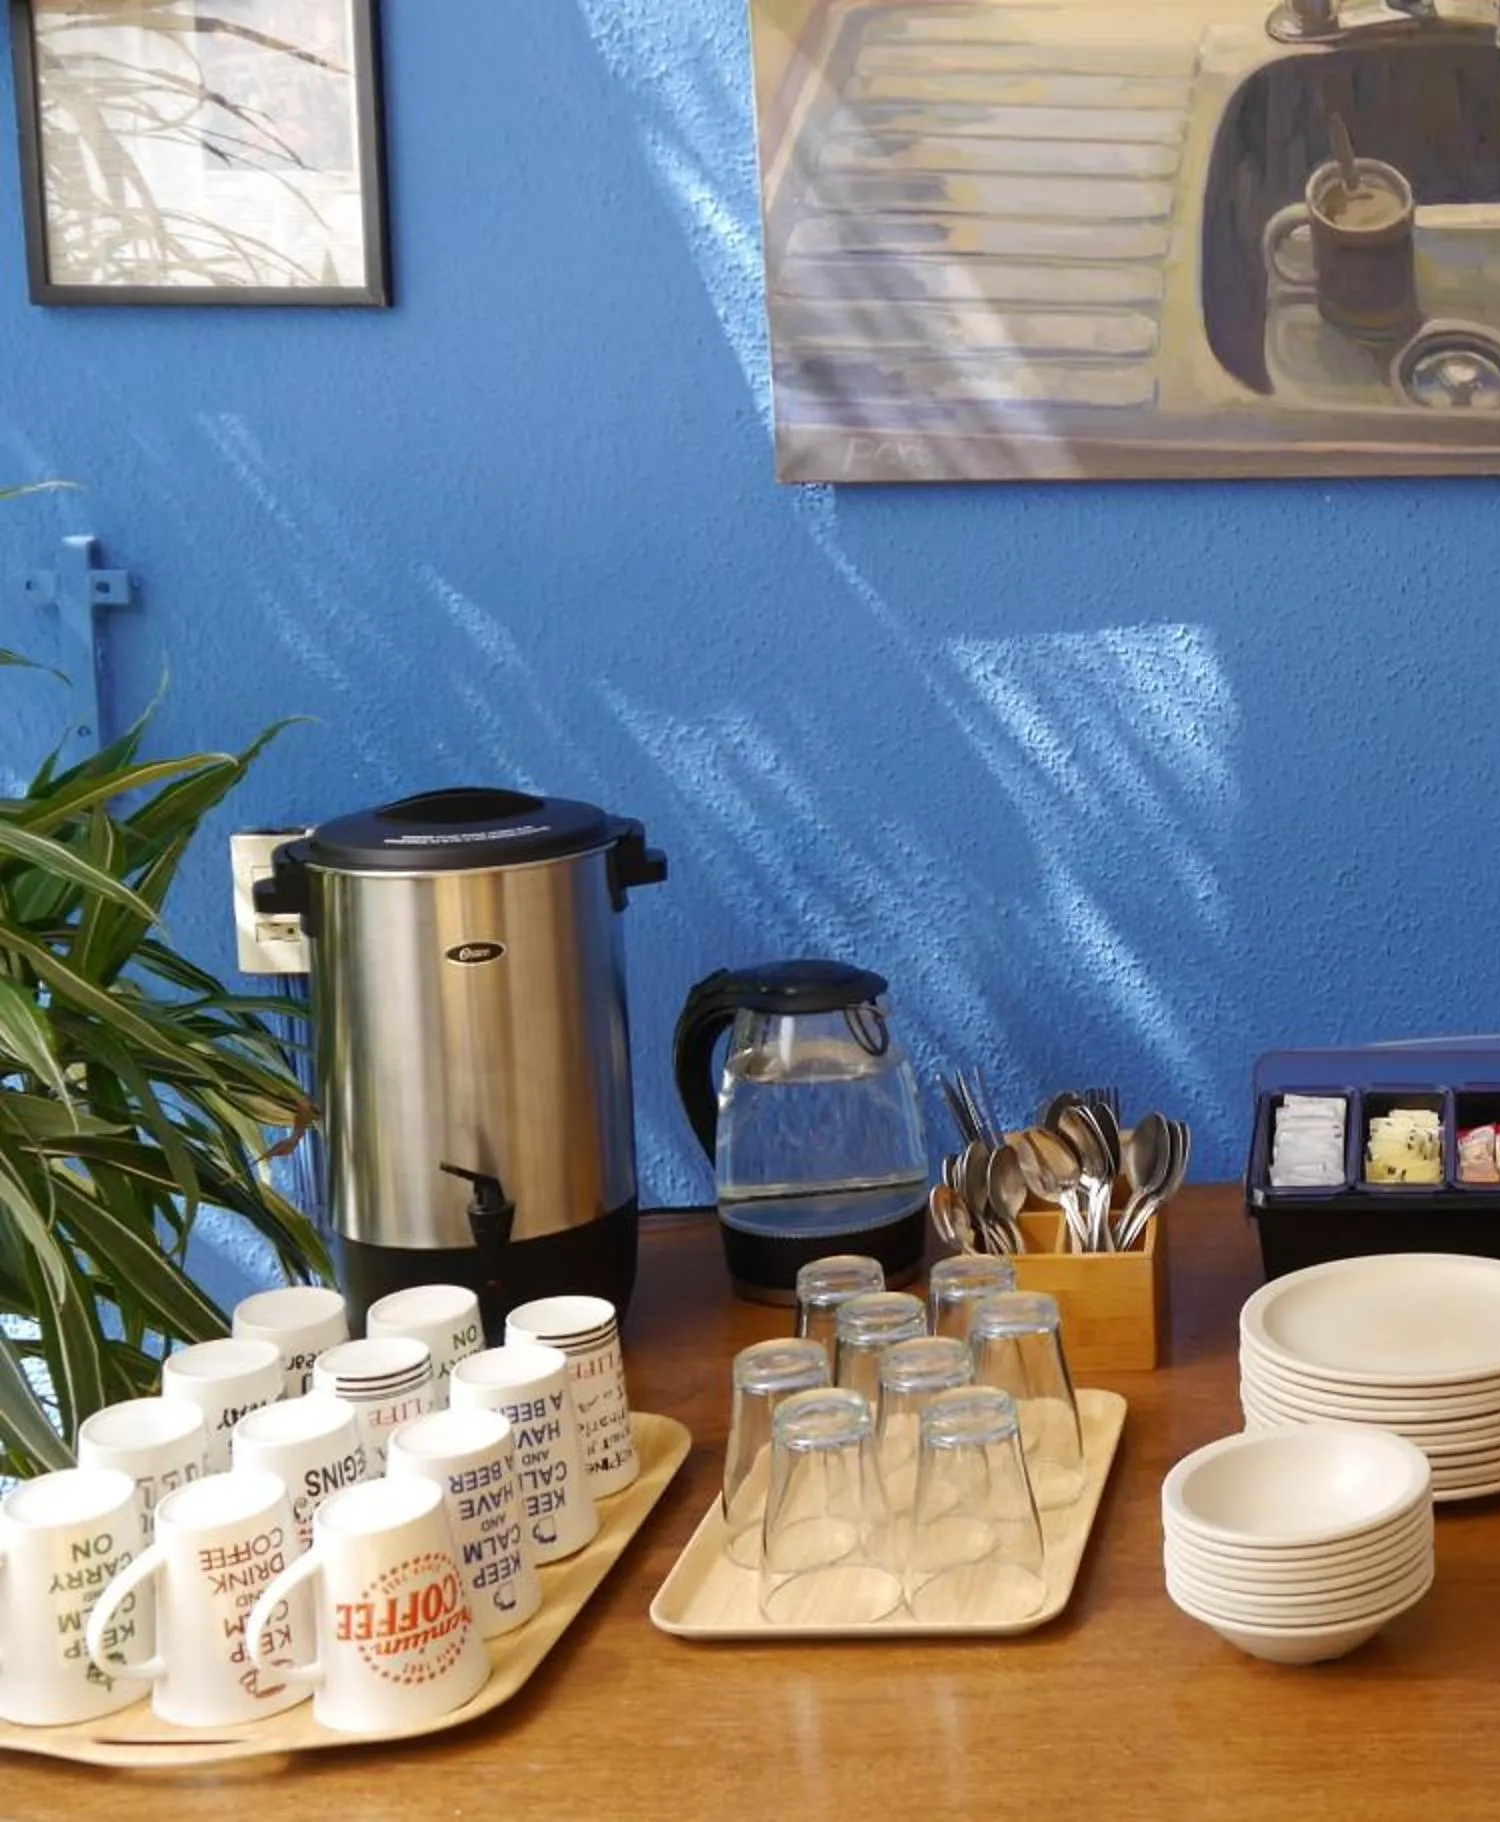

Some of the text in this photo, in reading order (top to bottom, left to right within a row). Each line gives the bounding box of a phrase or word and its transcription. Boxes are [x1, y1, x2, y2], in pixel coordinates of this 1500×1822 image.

[453, 1324, 477, 1350] ON
[500, 1390, 563, 1424] A BEE
[517, 1419, 561, 1449] HAV
[522, 1449, 550, 1467] AND
[448, 1460, 502, 1494] BEER
[518, 1460, 567, 1492] CAL
[460, 1484, 514, 1520] HAVE
[527, 1487, 567, 1517] KEE
[481, 1511, 507, 1533] AND
[71, 1532, 114, 1563] ON
[199, 1527, 284, 1571] COFFEE
[464, 1523, 521, 1563] CALM
[49, 1552, 134, 1595] CARRY
[207, 1551, 285, 1596] DRINK
[472, 1552, 521, 1589] KEEP
[336, 1573, 458, 1641] COFFEE
[63, 1619, 136, 1660] KEP
[229, 1624, 292, 1665] KEP
